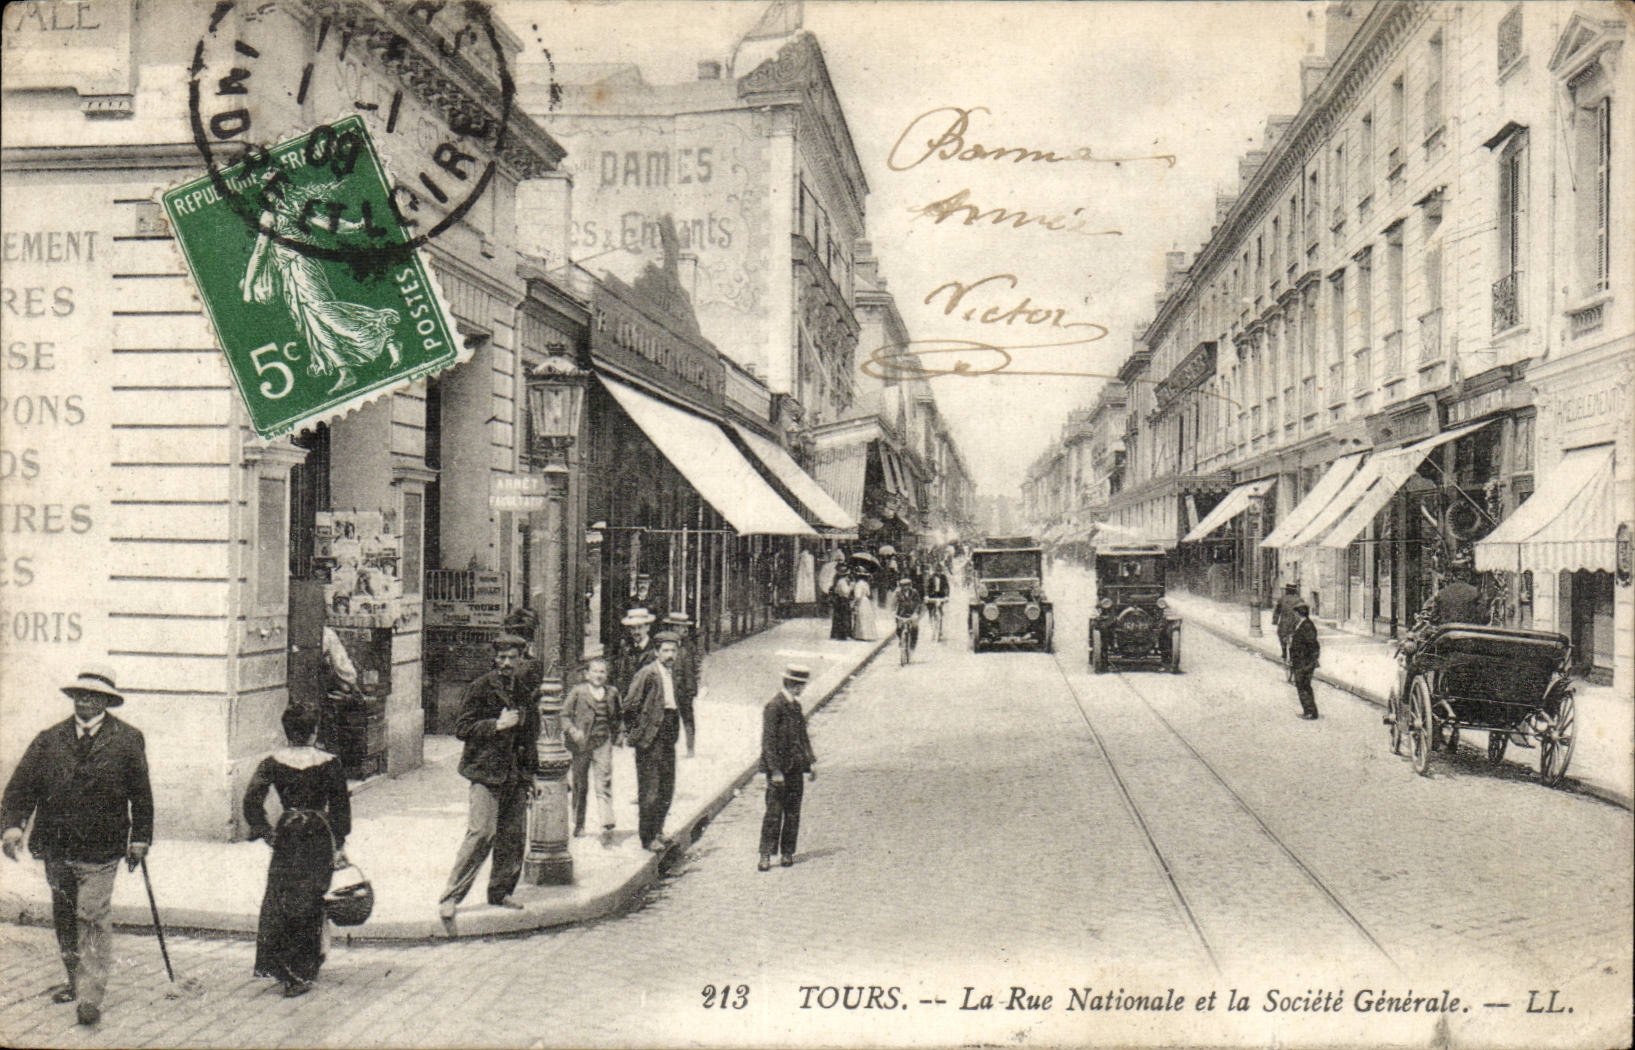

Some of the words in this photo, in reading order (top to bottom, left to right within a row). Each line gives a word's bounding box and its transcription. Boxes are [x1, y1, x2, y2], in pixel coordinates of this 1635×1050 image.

[601, 147, 713, 187] DAMES
[396, 267, 443, 351] POSTES
[6, 341, 56, 371] SE
